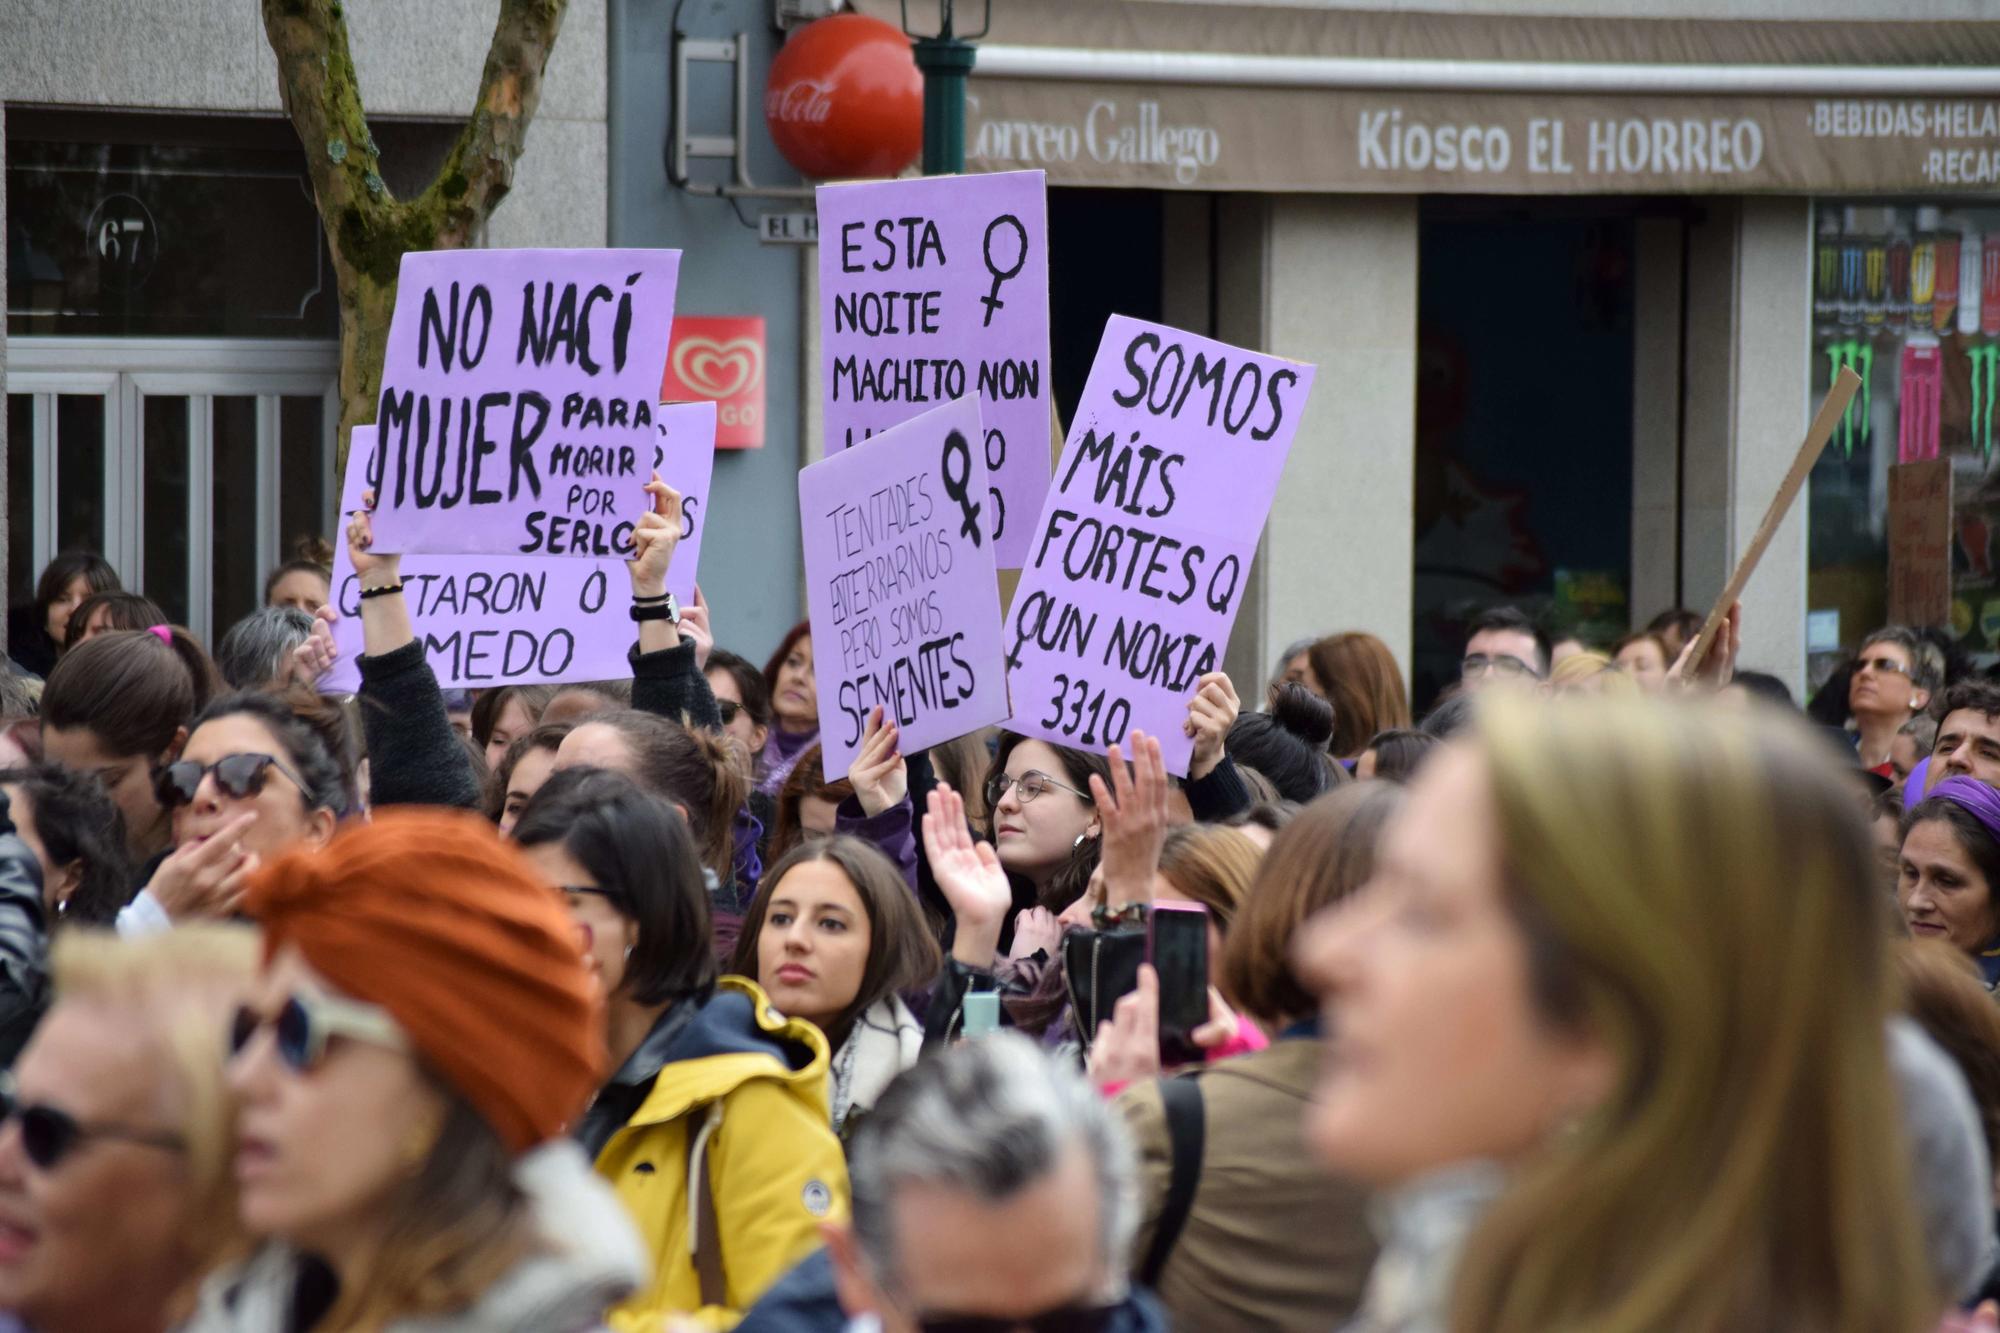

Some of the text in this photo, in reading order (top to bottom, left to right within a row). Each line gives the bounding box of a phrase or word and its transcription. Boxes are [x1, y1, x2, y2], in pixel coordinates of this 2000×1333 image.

[1085, 99, 1220, 184] Gallego
[1358, 111, 1763, 174] Kiosco EL HORREO
[1934, 102, 2000, 138] HELA
[100, 220, 144, 264] 67
[842, 217, 946, 273] ESTA
[418, 272, 643, 377] NO NACÍ
[835, 291, 942, 337] NOITE
[833, 355, 1039, 402] MACHITO NON
[1113, 332, 1298, 441] SOMOS
[373, 386, 551, 512] MUJER
[561, 392, 652, 431] PARA
[720, 404, 758, 428] GO
[549, 443, 636, 477] MORIR
[1060, 429, 1185, 518] MÁIS
[519, 511, 638, 556] SERLO
[567, 484, 616, 516] POR
[826, 472, 933, 562] TENTADES
[339, 571, 547, 617] QTARON
[830, 528, 953, 626] ENTERRARNOS
[1035, 510, 1205, 605] FORTES
[1207, 554, 1240, 615] Q
[423, 628, 574, 681] MEDO
[840, 590, 943, 672] PERO SOMOS
[1103, 616, 1217, 693] NOKIA
[839, 632, 975, 748] SEMENTES
[1041, 673, 1131, 747] 3310
